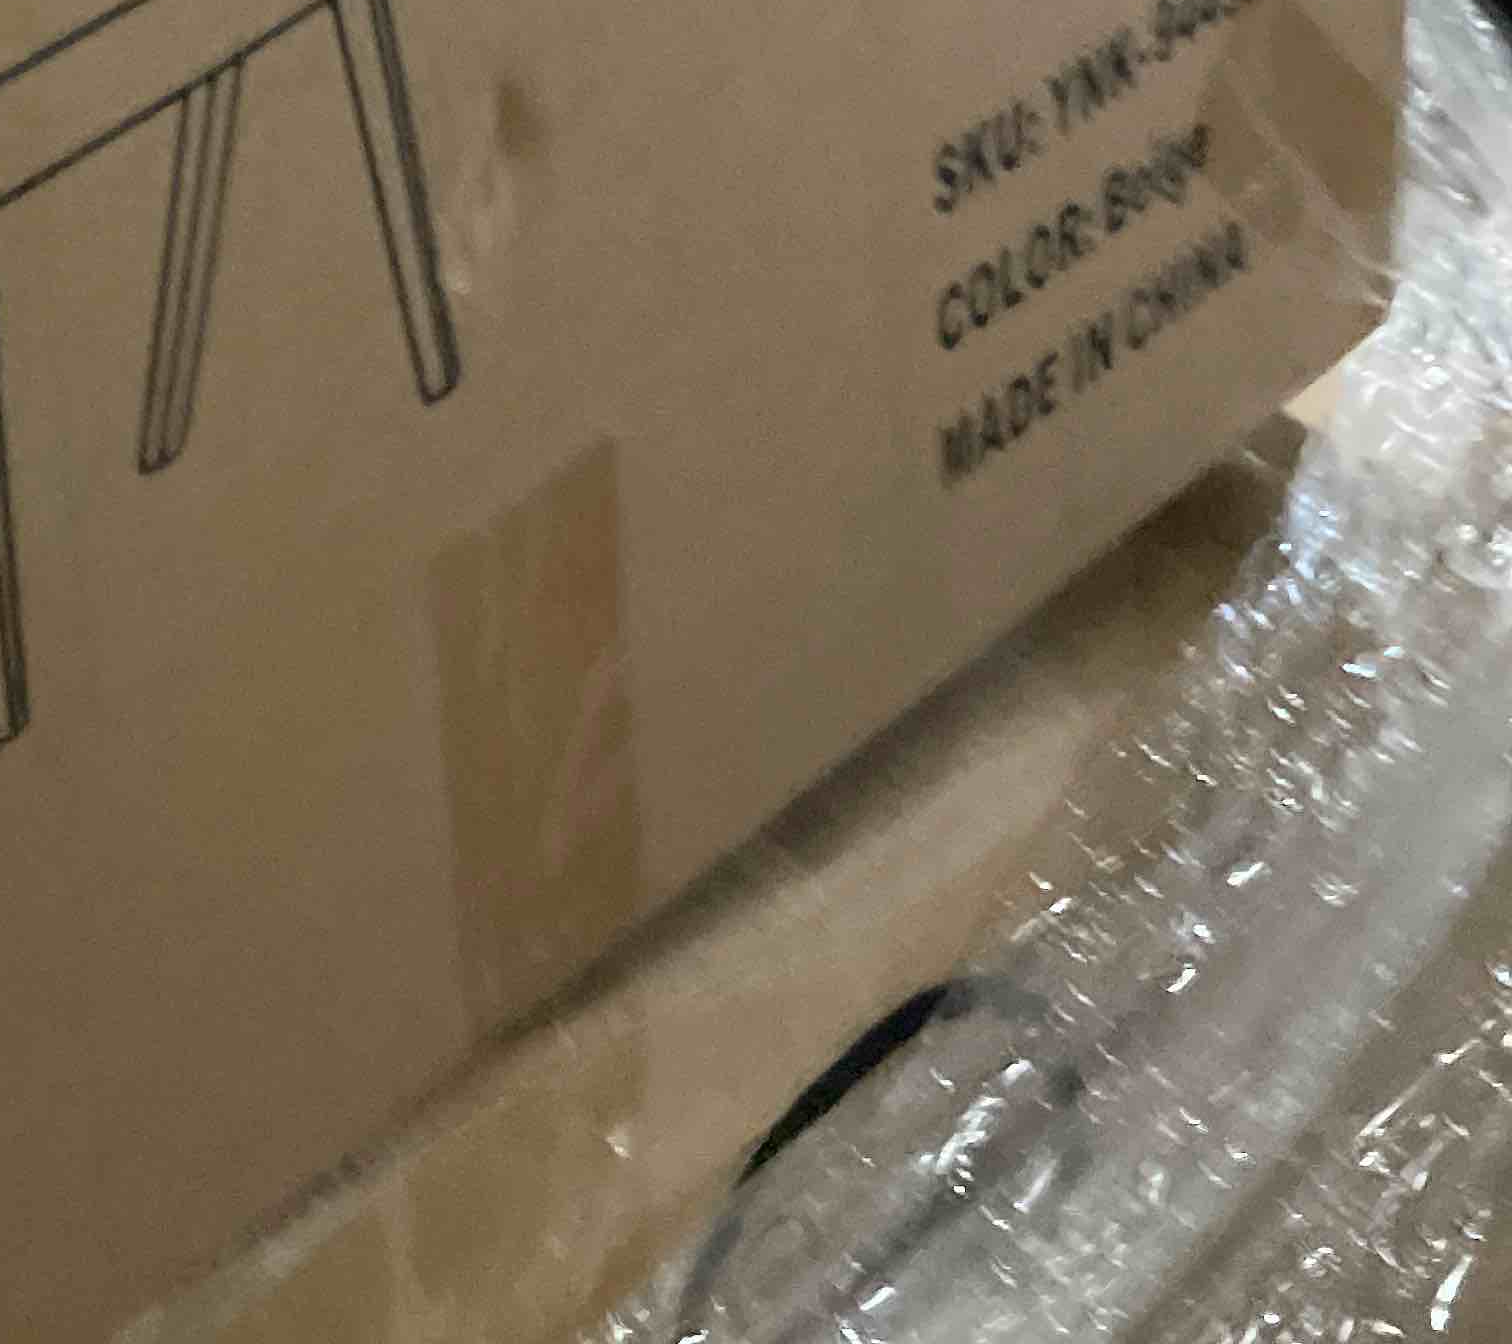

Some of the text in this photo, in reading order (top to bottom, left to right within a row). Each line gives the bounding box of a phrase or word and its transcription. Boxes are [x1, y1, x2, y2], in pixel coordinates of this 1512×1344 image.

[936, 203, 1098, 351] COLOR:
[937, 348, 1060, 488] MADE
[1068, 310, 1116, 394] IN
